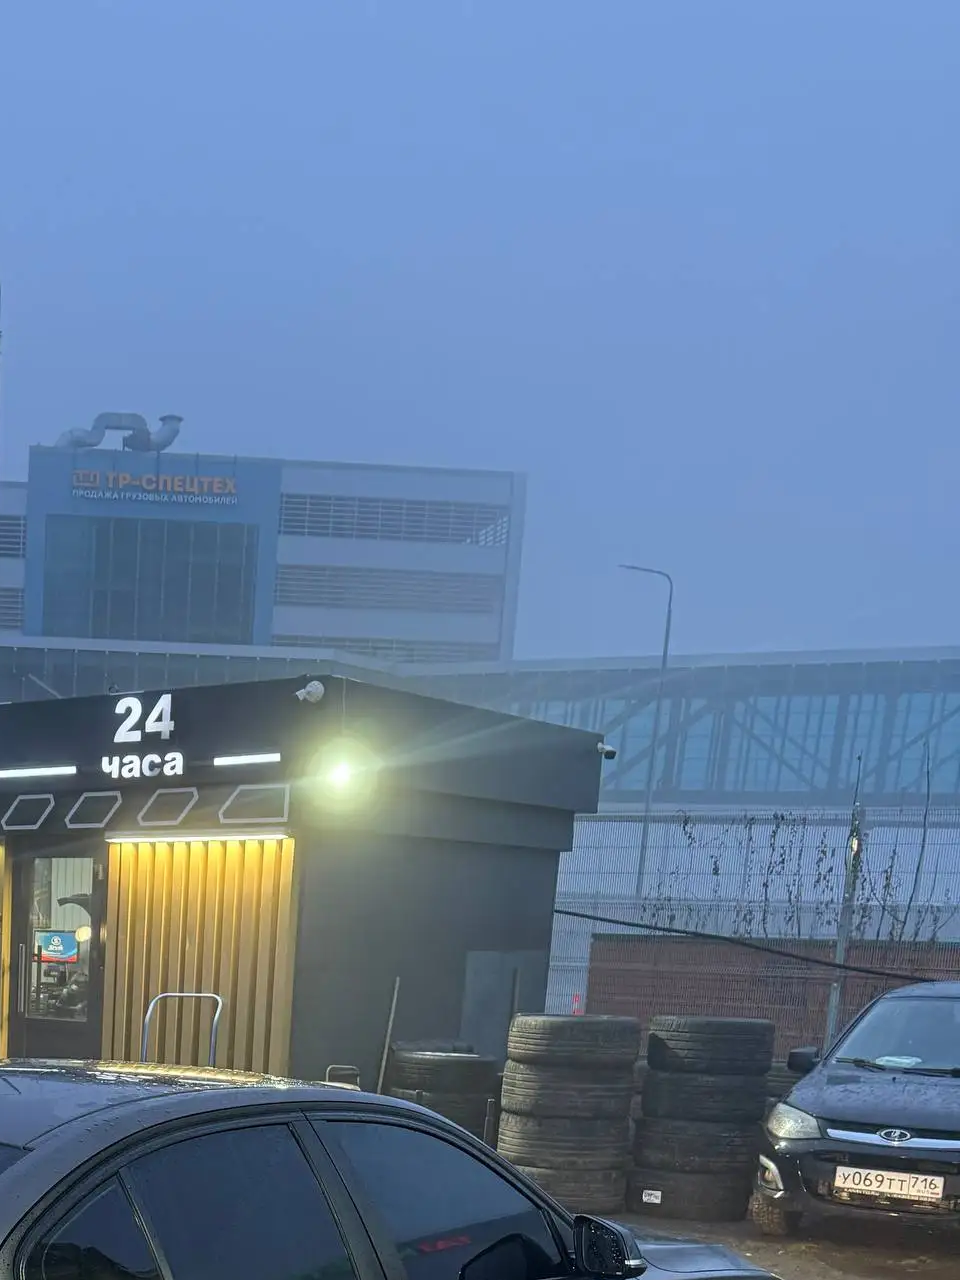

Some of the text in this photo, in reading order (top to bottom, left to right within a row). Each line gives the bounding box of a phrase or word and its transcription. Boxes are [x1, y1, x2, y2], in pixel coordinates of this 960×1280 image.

[106, 472, 237, 494] ТР-СПЕЦТЕХ
[72, 488, 238, 505] ПРОДАЖА ГРУЗОВЫХ АВТОМОБИЛЕЙ
[113, 693, 175, 743] 24
[101, 749, 184, 780] часа
[842, 1171, 937, 1191] У069ТТ 716
